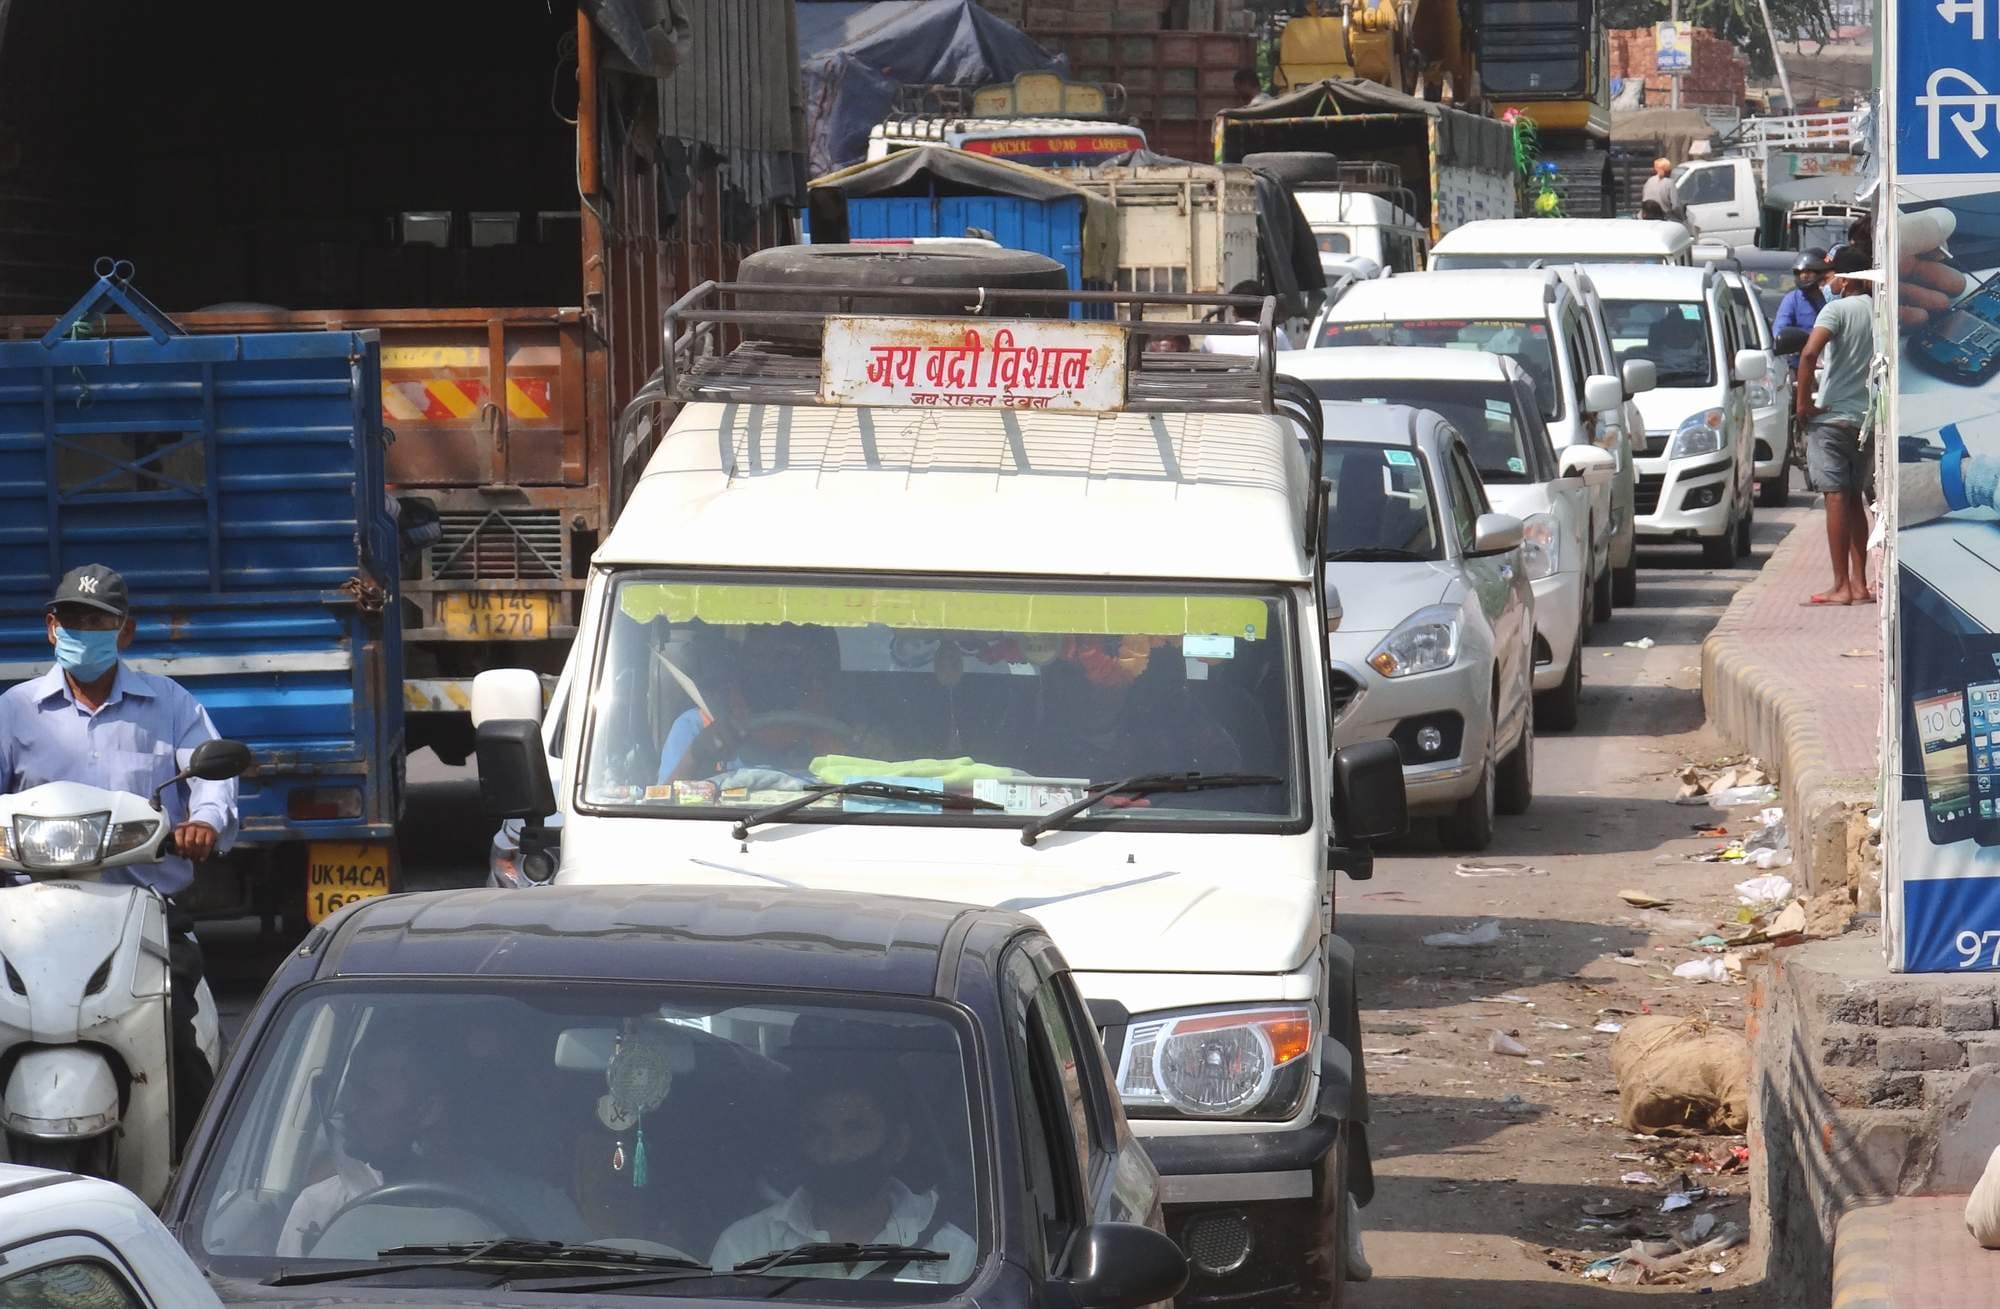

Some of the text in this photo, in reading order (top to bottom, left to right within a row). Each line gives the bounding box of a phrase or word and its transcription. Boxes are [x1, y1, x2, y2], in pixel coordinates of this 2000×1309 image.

[1916, 68, 2000, 160] रि
[866, 328, 1092, 390] जय बद्री विशाल
[911, 393, 939, 406] जय
[469, 612, 533, 634] A1270
[312, 864, 386, 887] UK14CA
[315, 892, 373, 915] 16
